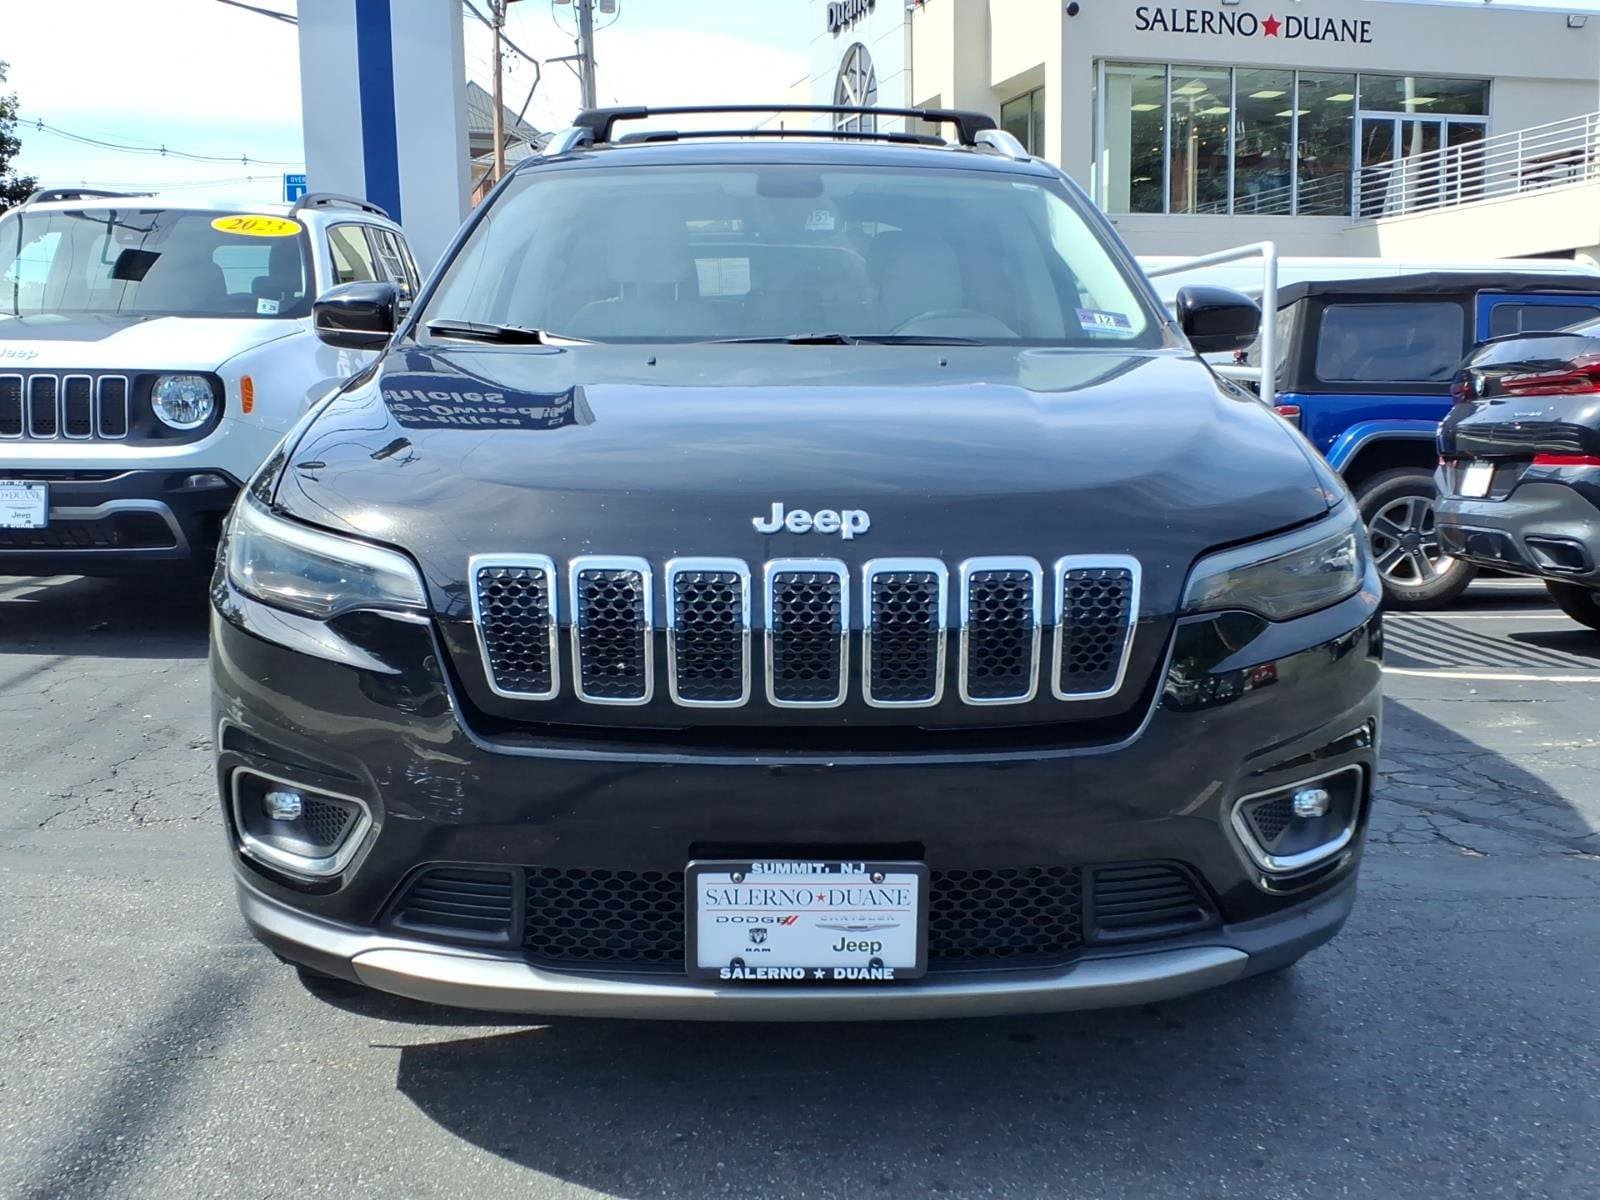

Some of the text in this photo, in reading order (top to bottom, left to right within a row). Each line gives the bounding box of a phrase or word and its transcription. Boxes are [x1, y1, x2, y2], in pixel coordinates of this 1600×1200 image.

[1135, 6, 1373, 44] SALERNO DUANE
[225, 218, 286, 232] 2023
[752, 502, 871, 540] Jeep
[751, 863, 866, 875] SUMMIT, NJ
[705, 888, 912, 906] SALERNO DUANE
[716, 915, 789, 924] DODGE
[832, 937, 883, 954] Jeep
[720, 968, 895, 980] SALERNO DUANE
